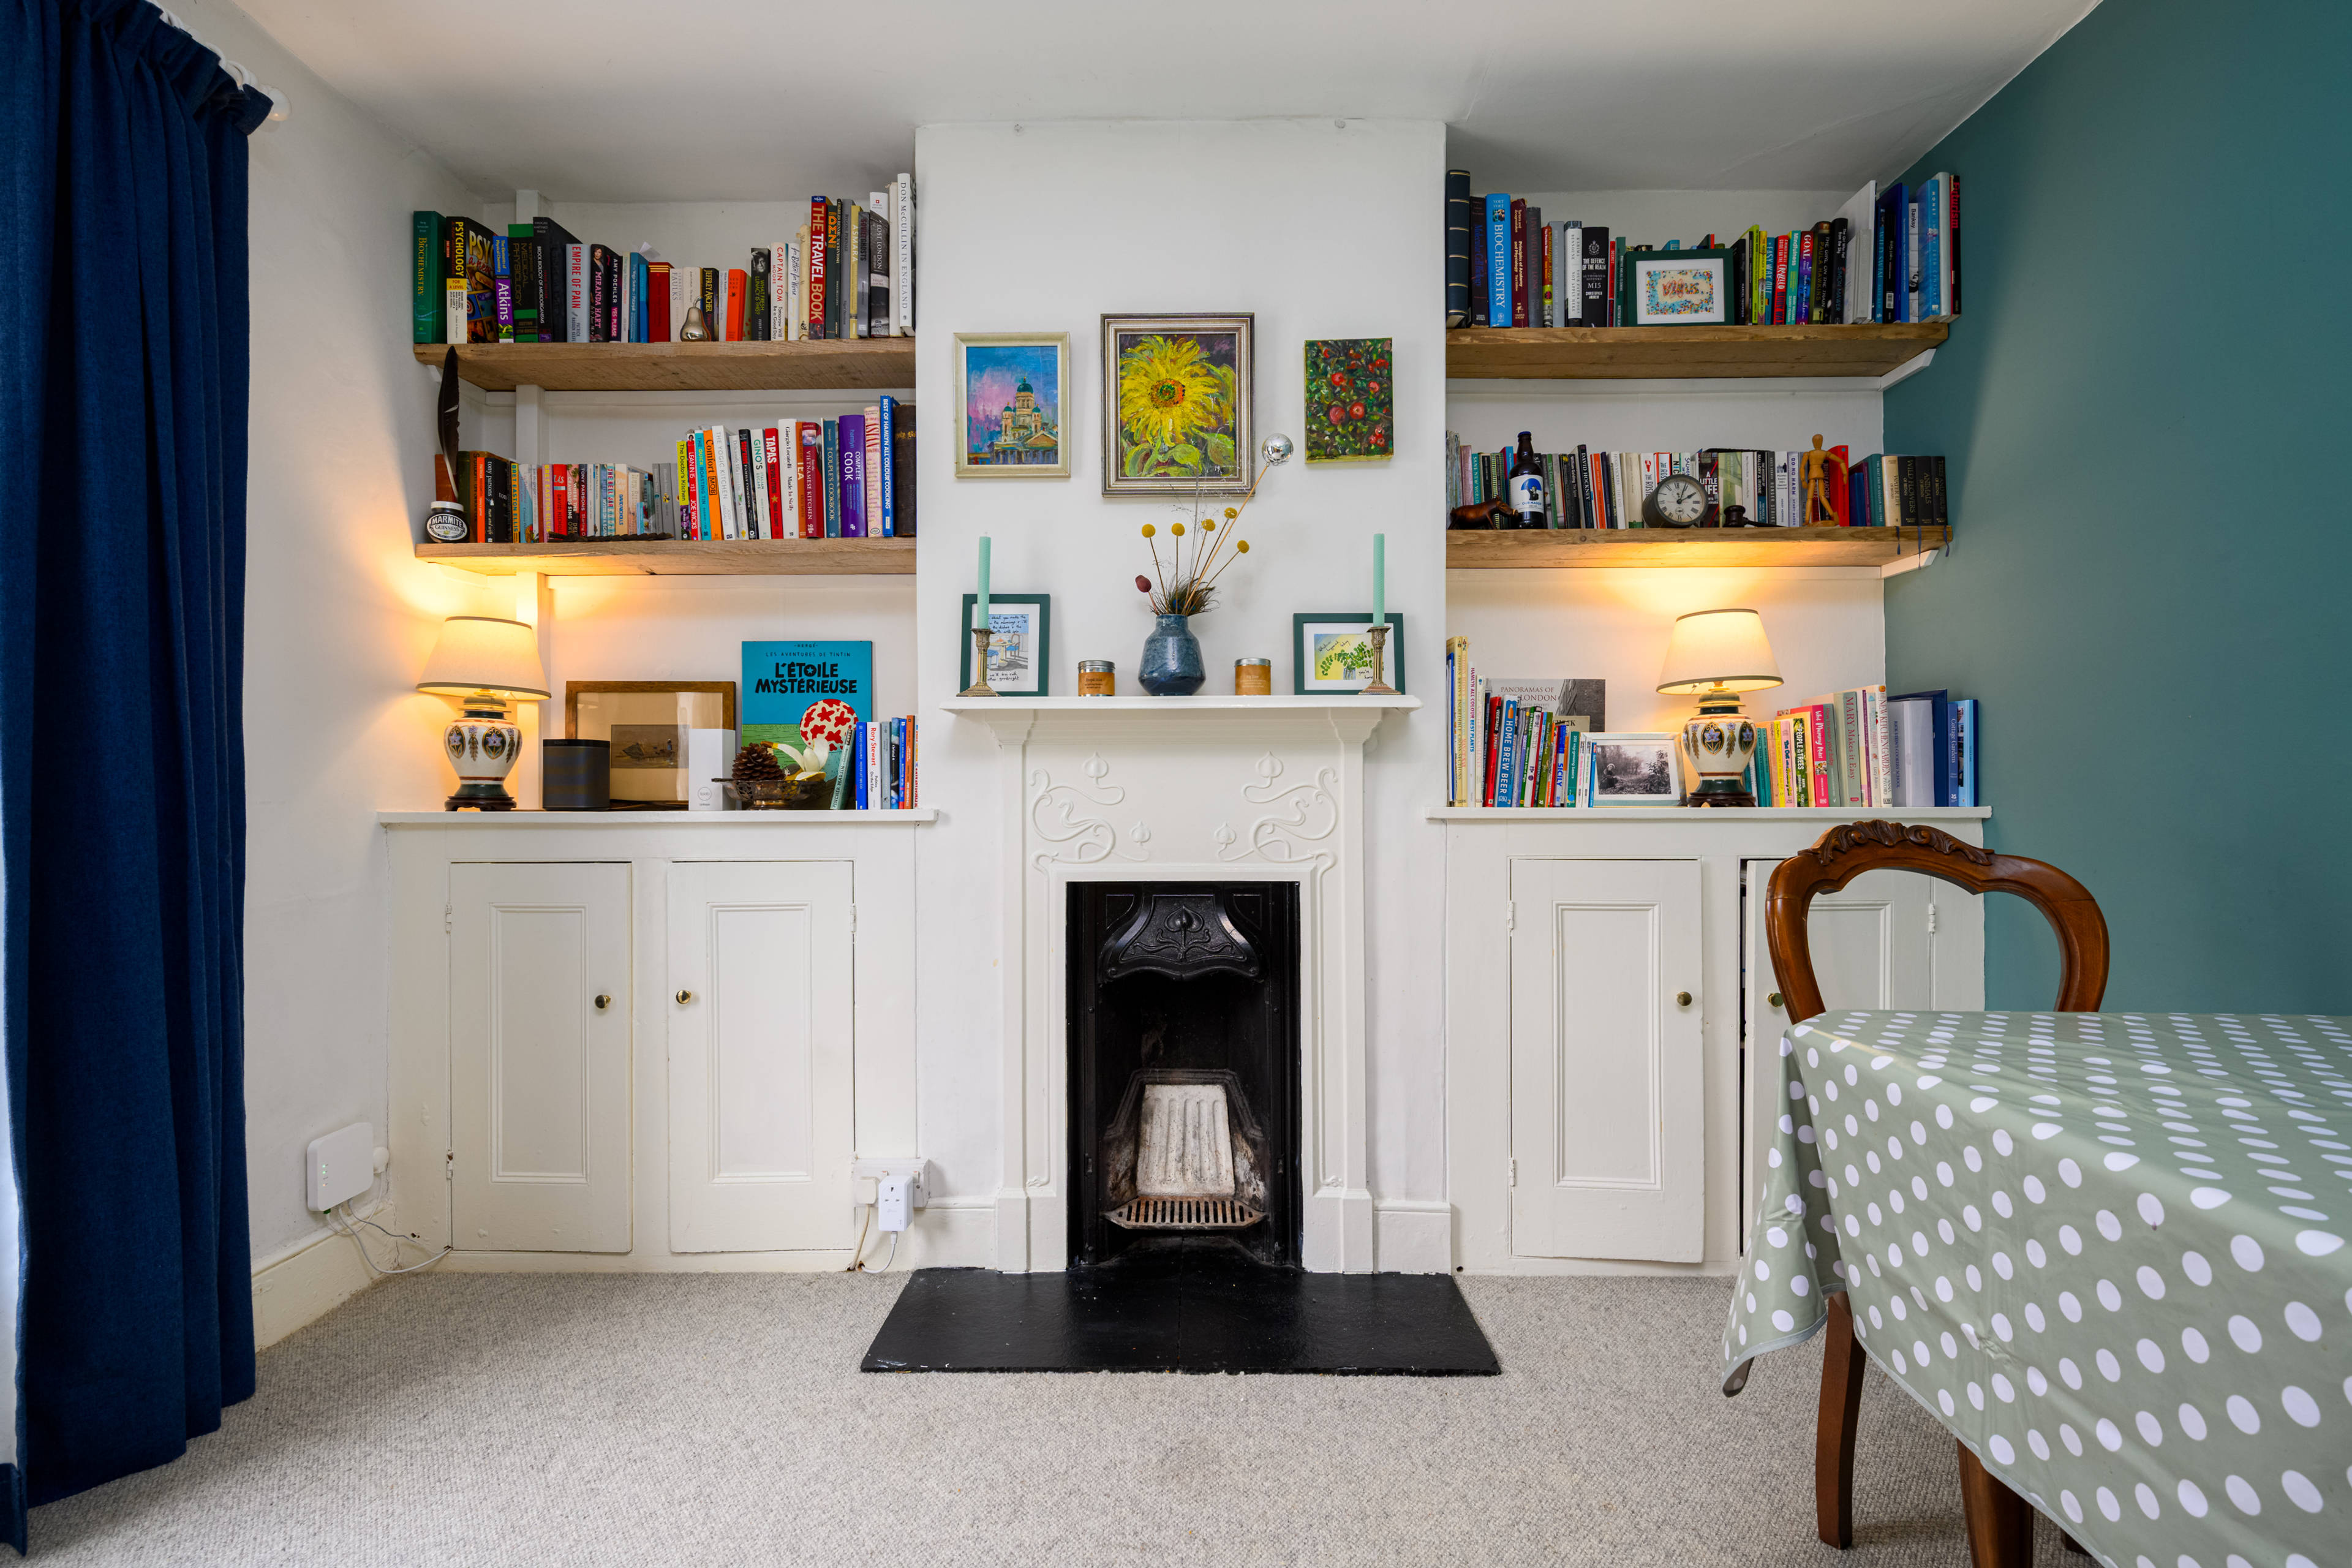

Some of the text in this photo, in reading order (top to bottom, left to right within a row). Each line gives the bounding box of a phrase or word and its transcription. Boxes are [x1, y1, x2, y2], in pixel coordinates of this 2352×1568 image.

[1951, 181, 1960, 228] Futurism
[455, 221, 464, 277] PSYCHOLOGY
[810, 205, 824, 321] THE TRAVEL BOOK
[902, 254, 907, 263] IN
[418, 237, 428, 295] BIOCHEMISTRY
[572, 246, 581, 309] EMPIRE OF PAIN
[705, 270, 714, 290] JEFFREY
[1494, 224, 1506, 307] BIOCHEMISTRY
[1823, 265, 1828, 274] ON
[498, 282, 511, 320] Atkins
[706, 439, 715, 473] Comfort
[754, 439, 763, 470] GINO'S
[844, 451, 853, 481] COOK
[432, 515, 464, 528] MARMITE
[755, 677, 858, 694] MYSTÉRIEUSE
[1845, 697, 1856, 726] MARY
[1847, 729, 1856, 752] Makes
[1502, 747, 1510, 769] BREW
[1847, 763, 1857, 780] Easy
[1881, 745, 1890, 777] GARDEN
[1499, 774, 1508, 793] BEER
